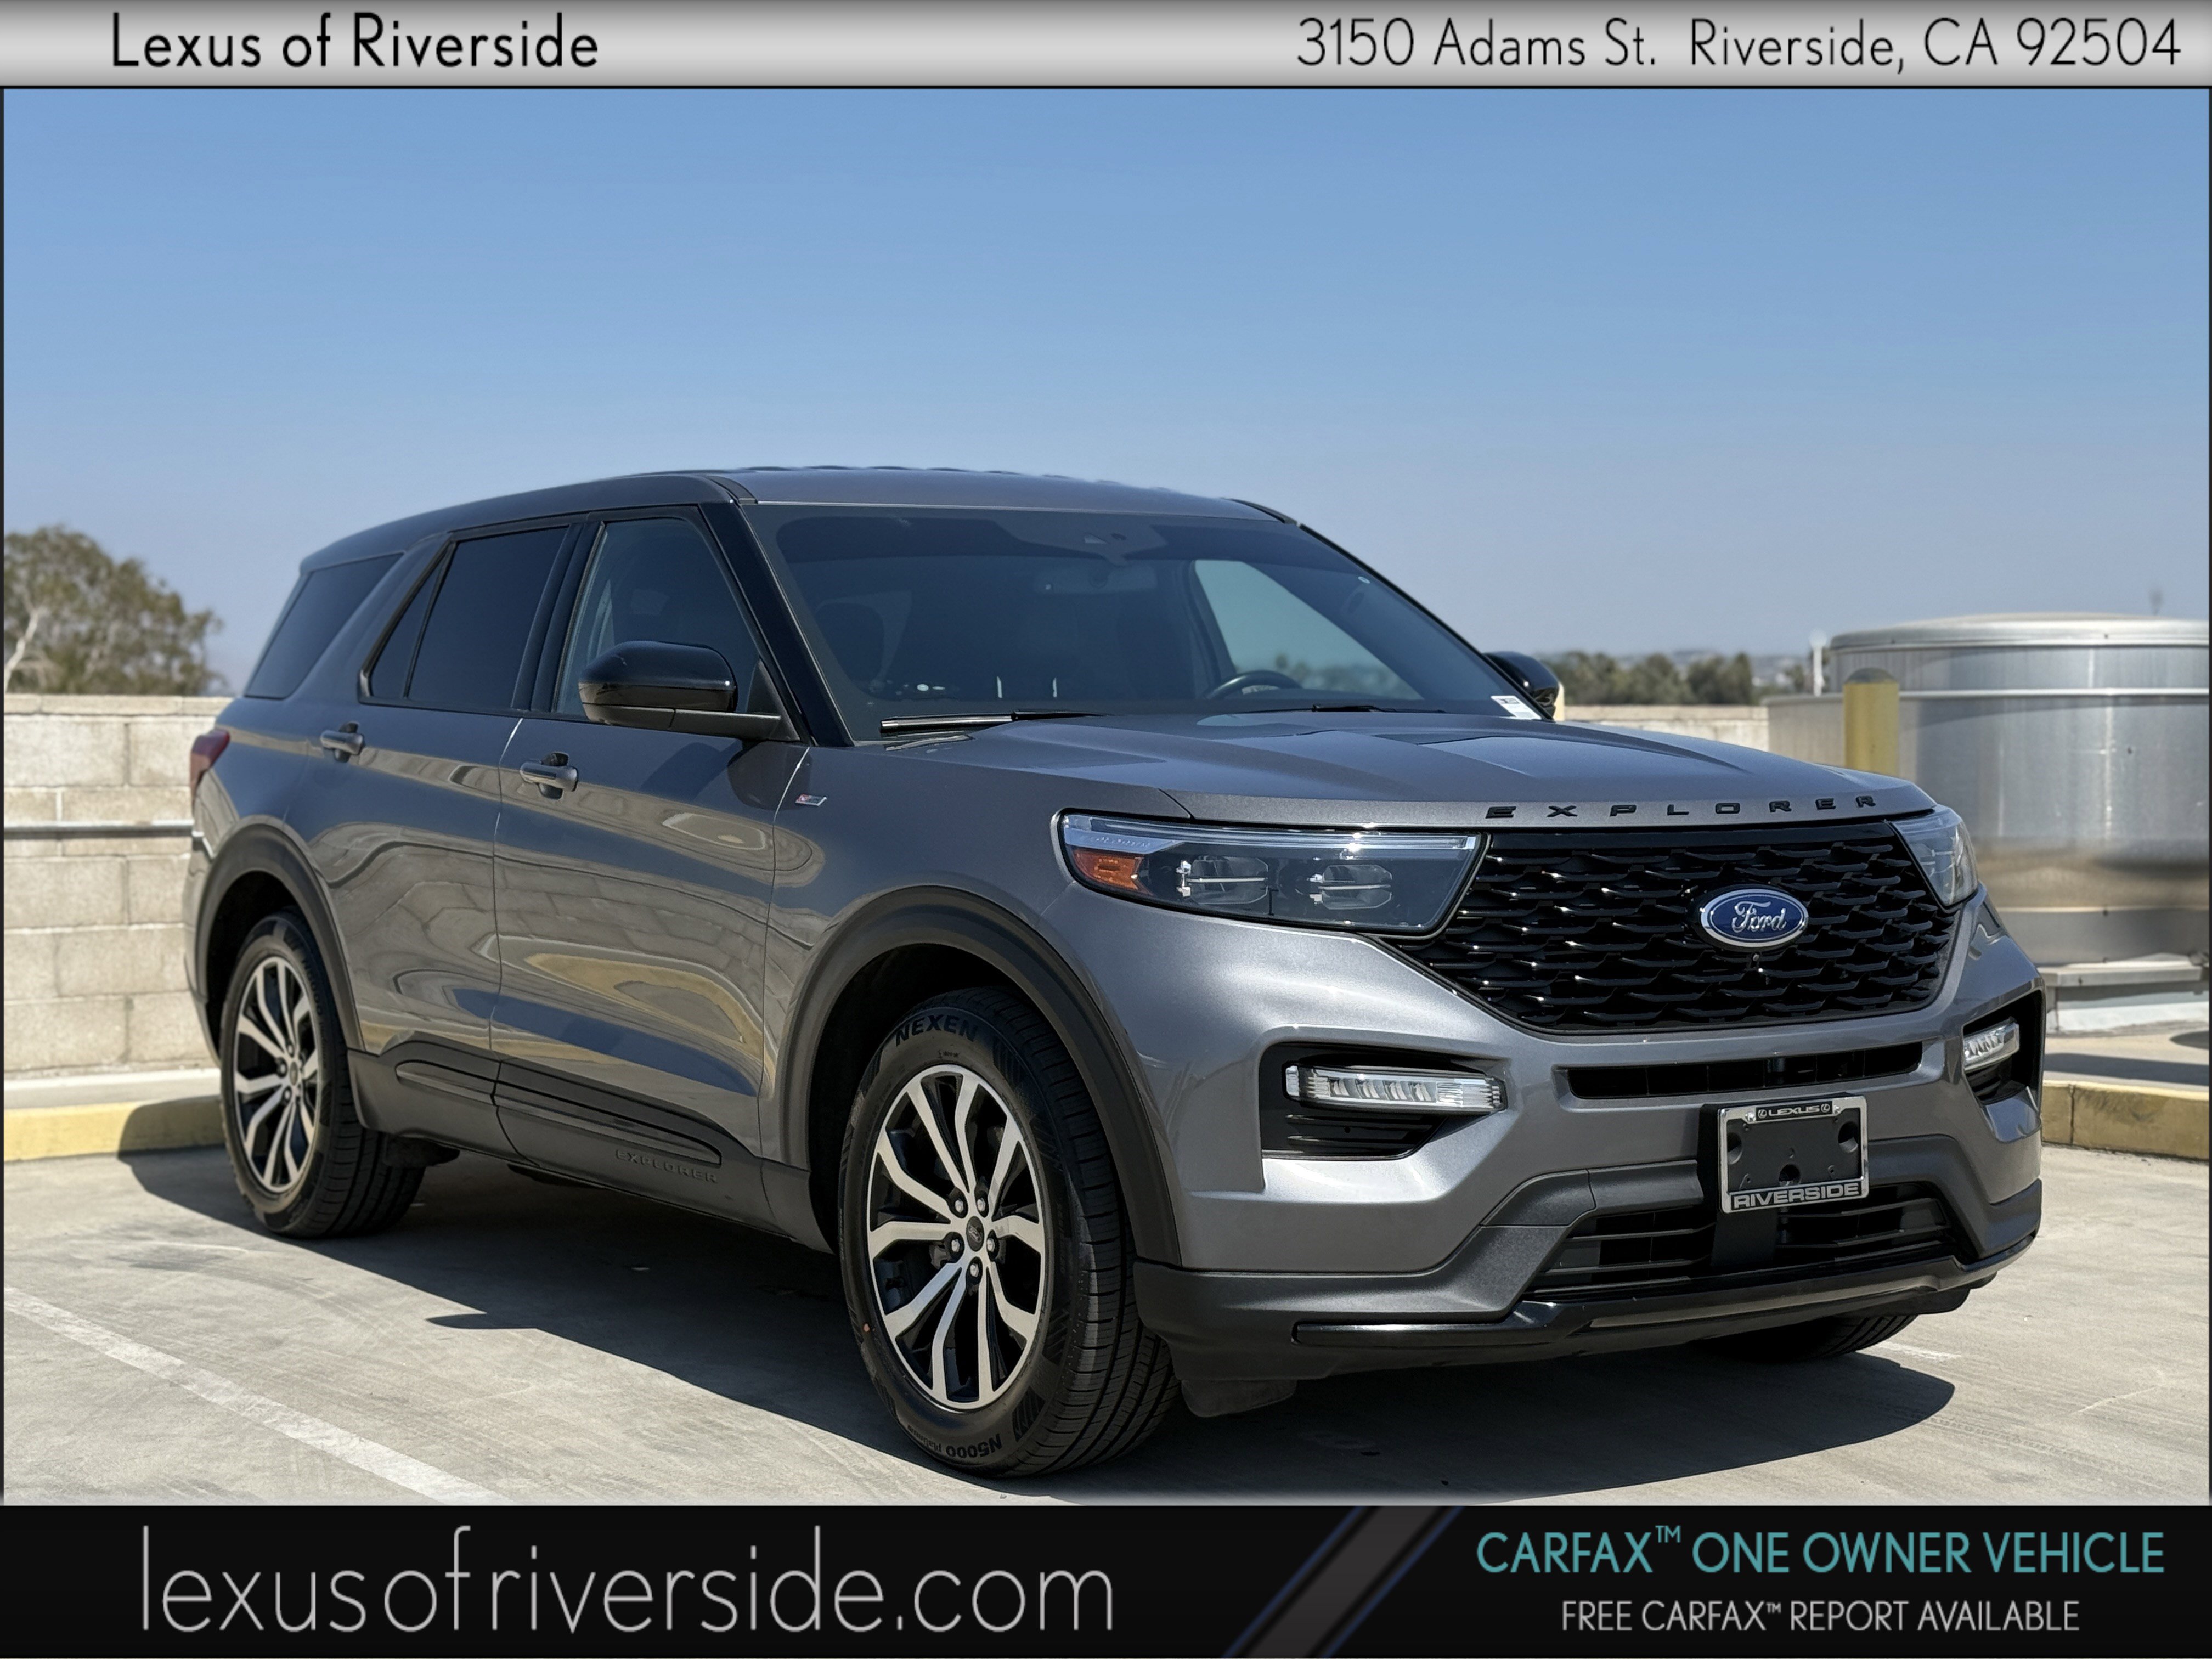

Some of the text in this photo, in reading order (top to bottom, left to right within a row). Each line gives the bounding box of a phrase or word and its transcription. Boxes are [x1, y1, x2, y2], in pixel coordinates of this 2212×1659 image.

[1485, 795, 1877, 819] EXPLORER
[1731, 901, 1787, 933] Ford
[895, 1014, 978, 1047] NEXEN
[1768, 1104, 1820, 1116] LEXUS
[615, 1149, 718, 1183] EXPLORER
[1734, 1182, 1860, 1209] RIVERSIDE
[945, 1433, 1002, 1459] N5000
